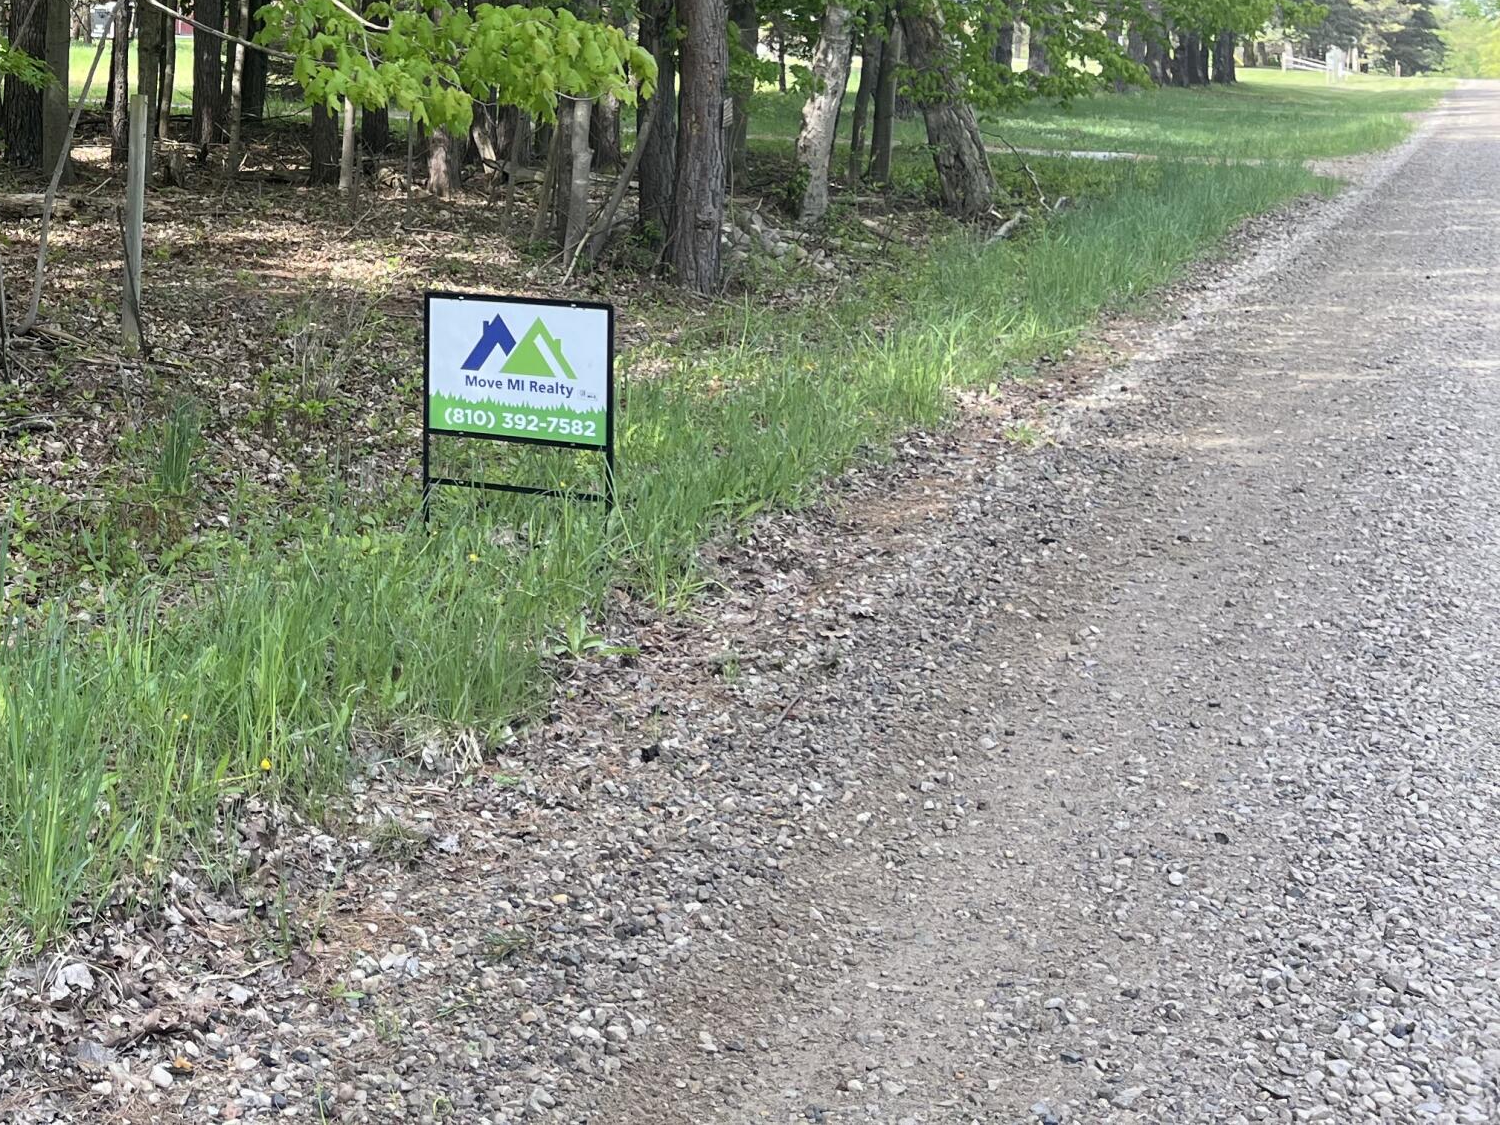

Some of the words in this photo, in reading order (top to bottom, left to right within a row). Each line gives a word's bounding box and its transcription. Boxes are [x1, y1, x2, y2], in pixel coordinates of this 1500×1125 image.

[465, 375, 503, 389] Move
[507, 378, 524, 391] MI
[529, 380, 574, 399] Realty
[444, 407, 496, 429] (810)
[502, 412, 596, 437] 392-7582
